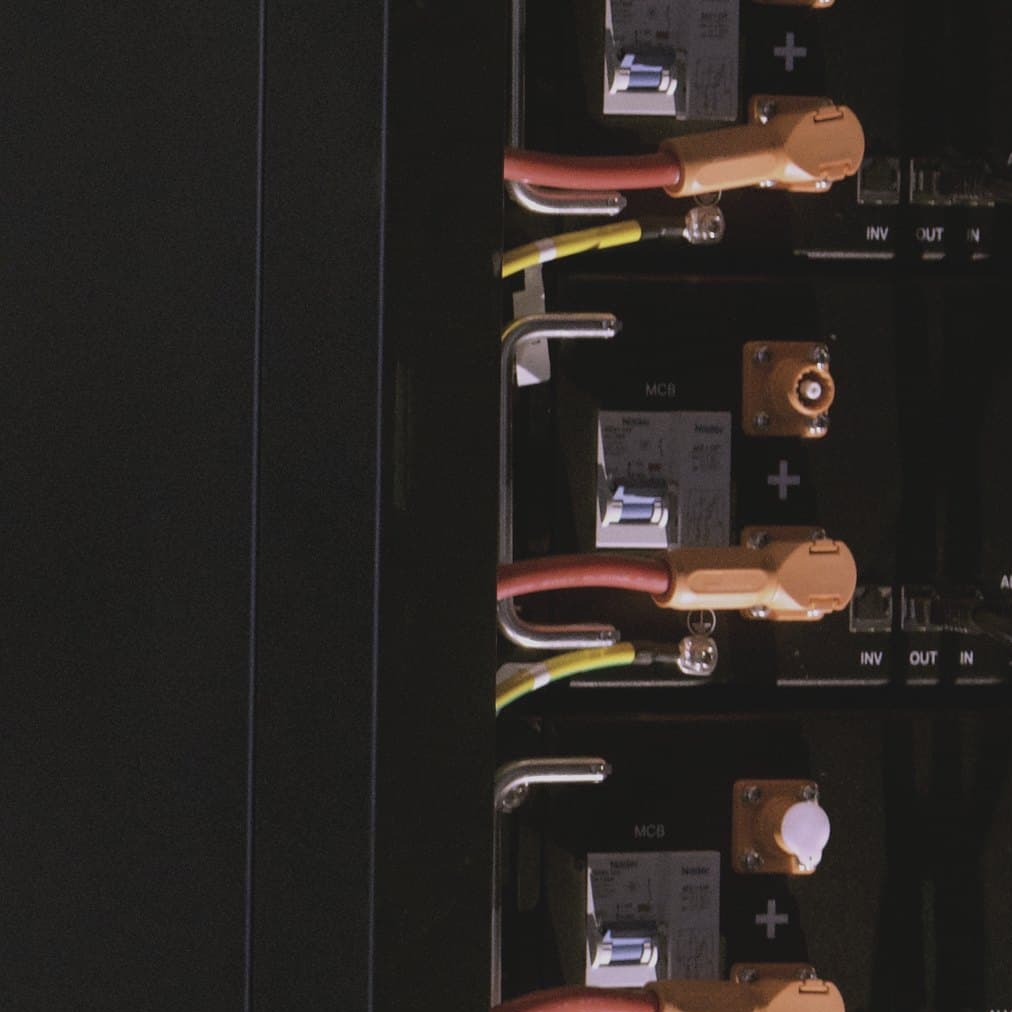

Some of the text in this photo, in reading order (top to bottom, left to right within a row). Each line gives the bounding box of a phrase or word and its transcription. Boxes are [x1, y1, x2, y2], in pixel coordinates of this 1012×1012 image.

[866, 226, 889, 241] INV
[916, 227, 944, 242] OUT
[967, 227, 981, 242] IN
[646, 382, 676, 397] MCB
[860, 651, 883, 666] INV
[909, 651, 938, 666] OUT
[959, 651, 974, 666] IN
[634, 823, 665, 839] MCB
